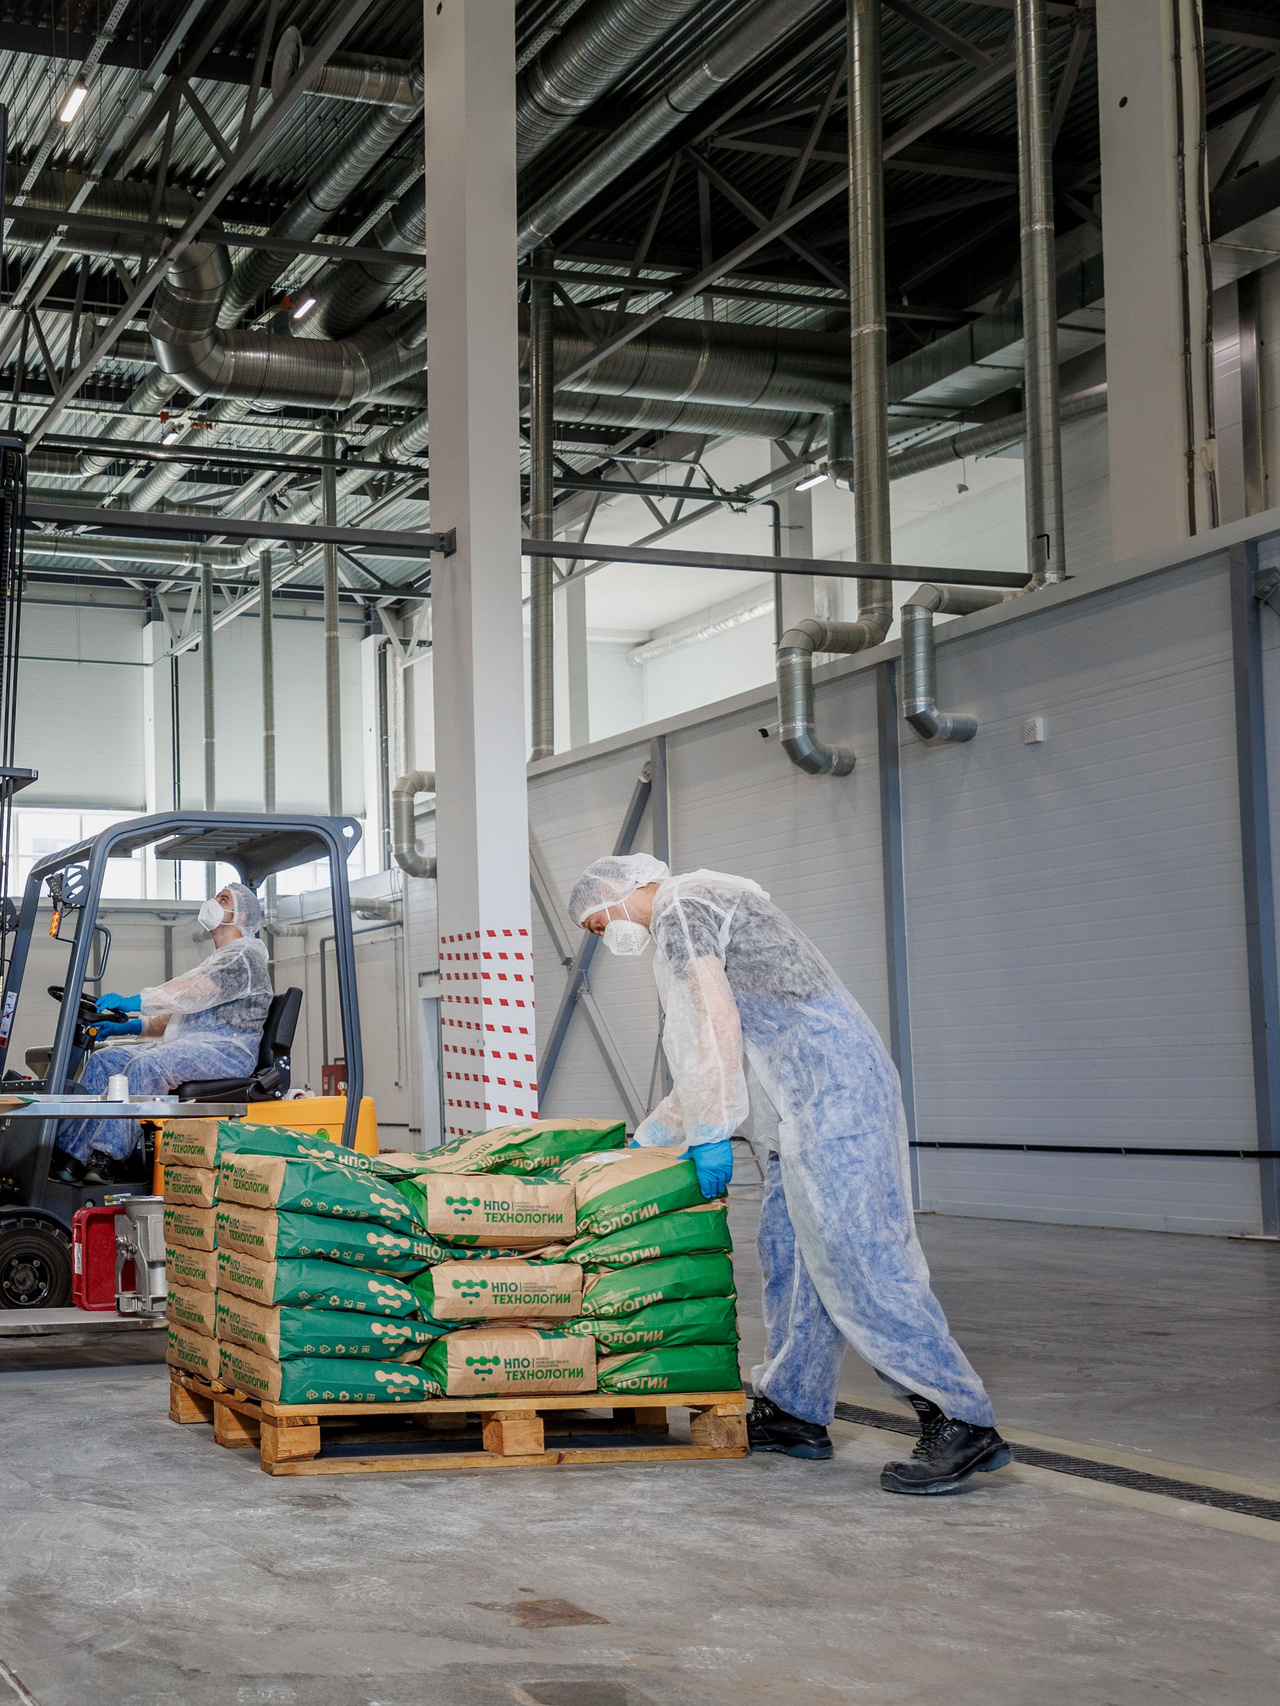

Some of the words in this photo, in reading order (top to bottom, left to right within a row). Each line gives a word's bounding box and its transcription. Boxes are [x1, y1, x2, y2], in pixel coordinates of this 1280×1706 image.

[338, 1154, 369, 1170] НПО
[483, 1200, 510, 1211] НПО
[484, 1212, 564, 1224] ТЕХНОЛОГИИ
[413, 1242, 442, 1260] НПО
[491, 1282, 518, 1293] НПО
[492, 1293, 571, 1305] ТЕХНОЛОГИИ
[597, 1330, 664, 1344] ОЛОГИИ
[504, 1357, 531, 1369] НПО
[504, 1368, 584, 1381] ТЕХНОЛОГИИ
